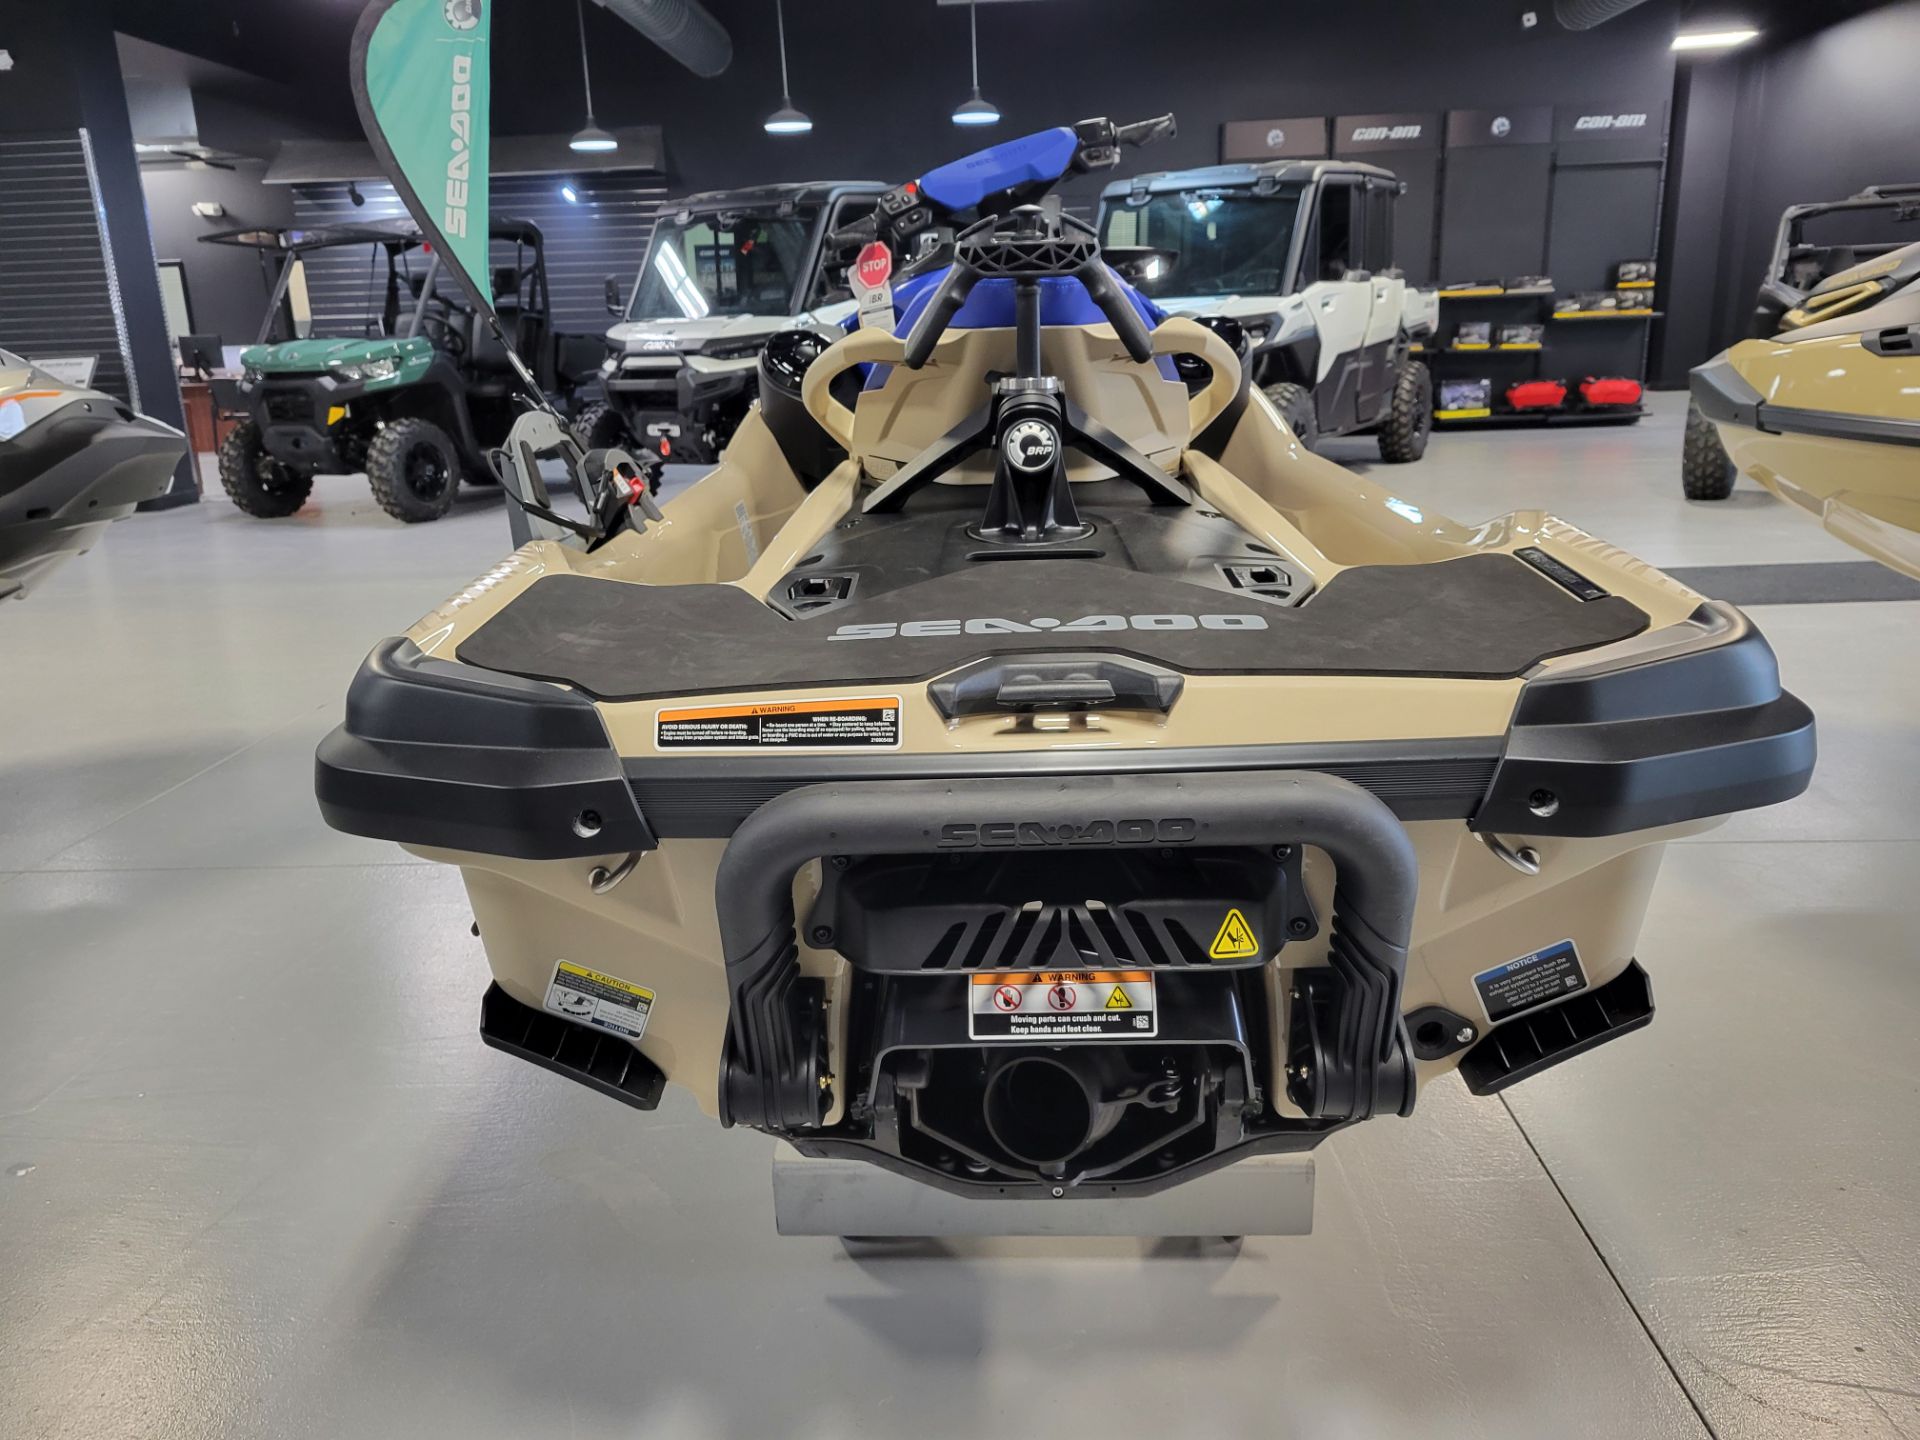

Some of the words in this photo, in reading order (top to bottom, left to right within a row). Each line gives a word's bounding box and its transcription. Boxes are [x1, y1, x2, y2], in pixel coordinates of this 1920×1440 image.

[862, 258, 887, 272] STOP
[1027, 446, 1052, 455] BRP
[760, 705, 795, 713] WARNING
[1506, 954, 1539, 972] NOTICE
[1048, 973, 1096, 982] WARNING
[594, 974, 631, 991] CAUTION
[1011, 1015, 1037, 1024] Moving
[1038, 1015, 1056, 1024] parts
[1072, 1015, 1091, 1023] crush
[1093, 1014, 1106, 1022] and
[1011, 1026, 1029, 1034] Keep
[1052, 1025, 1065, 1033] and
[1067, 1025, 1081, 1033] feet
[1082, 1025, 1102, 1033] clear.
